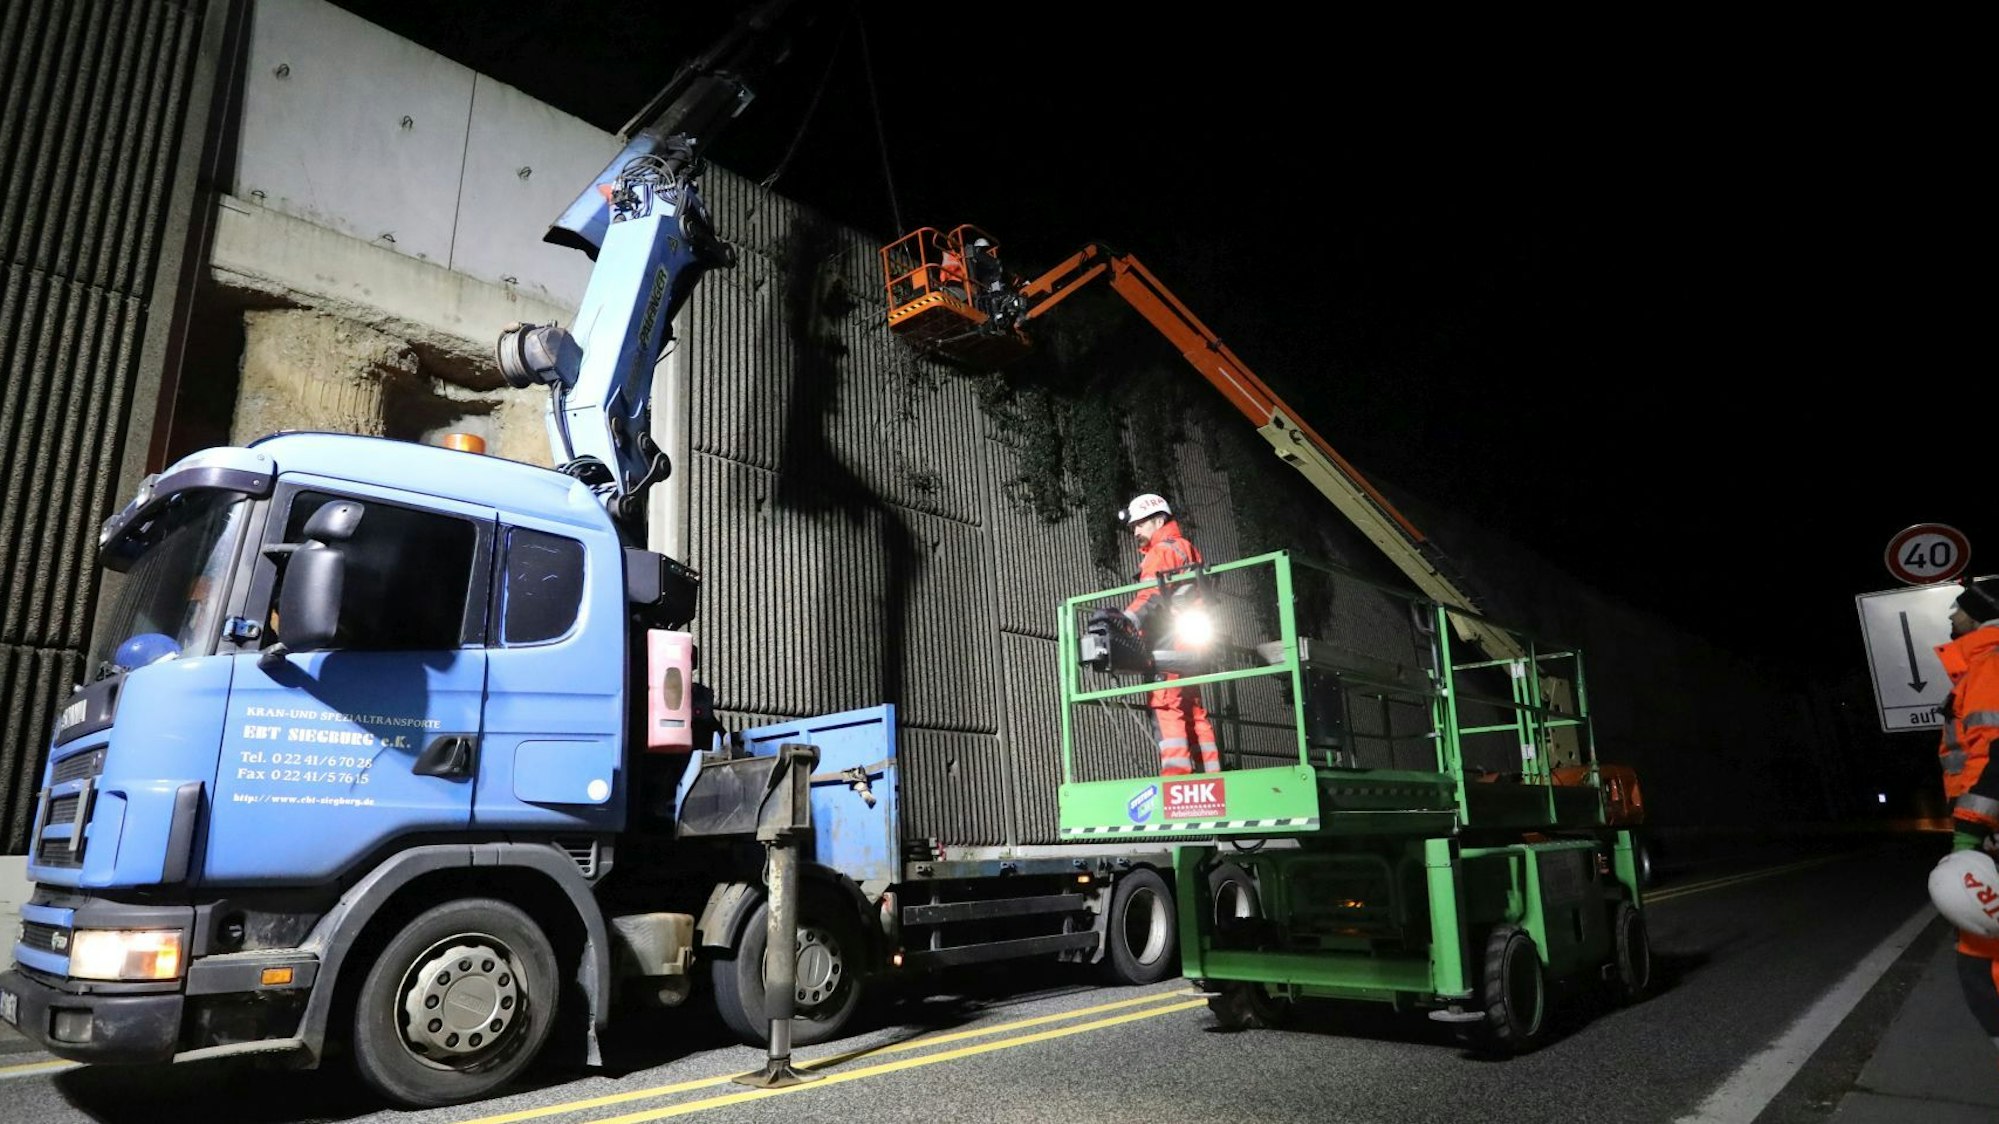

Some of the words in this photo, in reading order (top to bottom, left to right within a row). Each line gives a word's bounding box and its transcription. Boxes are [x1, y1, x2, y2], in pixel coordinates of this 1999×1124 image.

[1904, 541, 1951, 569] 40
[246, 706, 317, 721] KRAN-UND
[320, 711, 441, 729] SPEZIALTRANSPORTE
[1909, 709, 1938, 725] auf
[242, 725, 282, 741] EBT
[287, 727, 375, 747] SIEGBURG
[240, 751, 267, 763] Tel.
[236, 767, 265, 780] Fax
[1170, 783, 1217, 805] SHK
